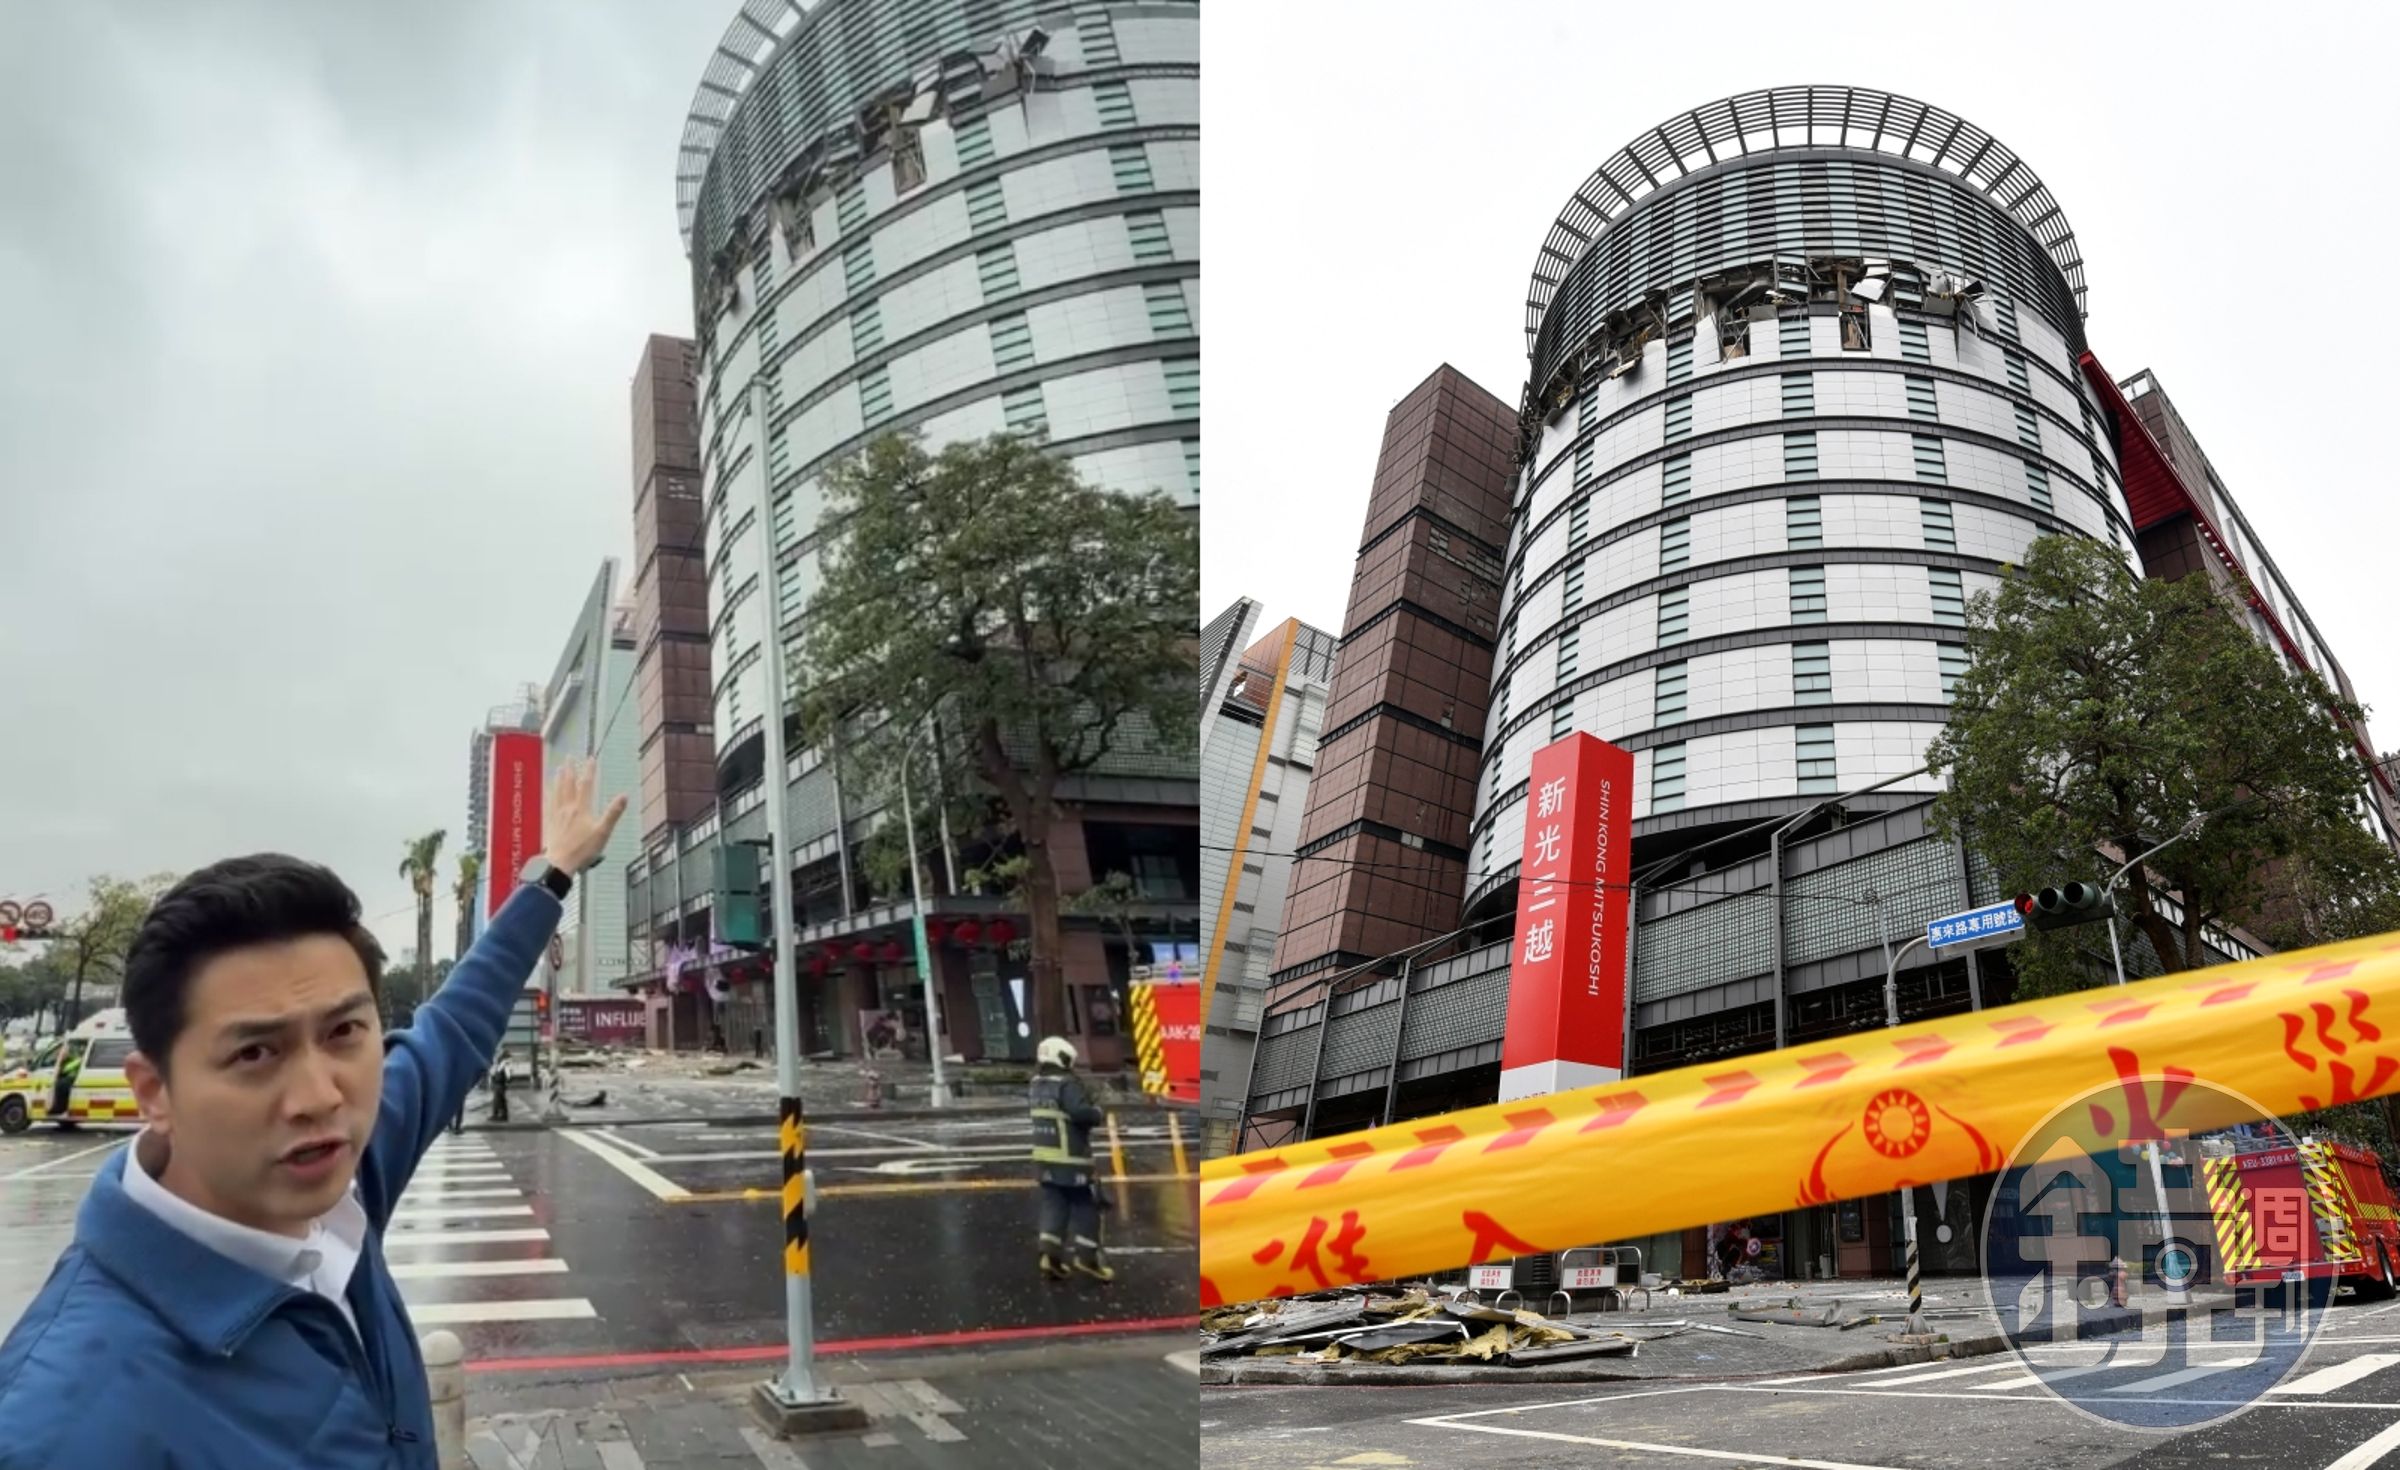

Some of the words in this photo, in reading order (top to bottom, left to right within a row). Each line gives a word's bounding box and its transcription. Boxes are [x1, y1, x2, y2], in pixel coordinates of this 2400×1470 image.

[1599, 778, 1611, 821] SHIN
[1523, 776, 1566, 966] 新光三越
[1595, 822, 1609, 874] KONG
[1588, 876, 1606, 996] MITSUKOSHI
